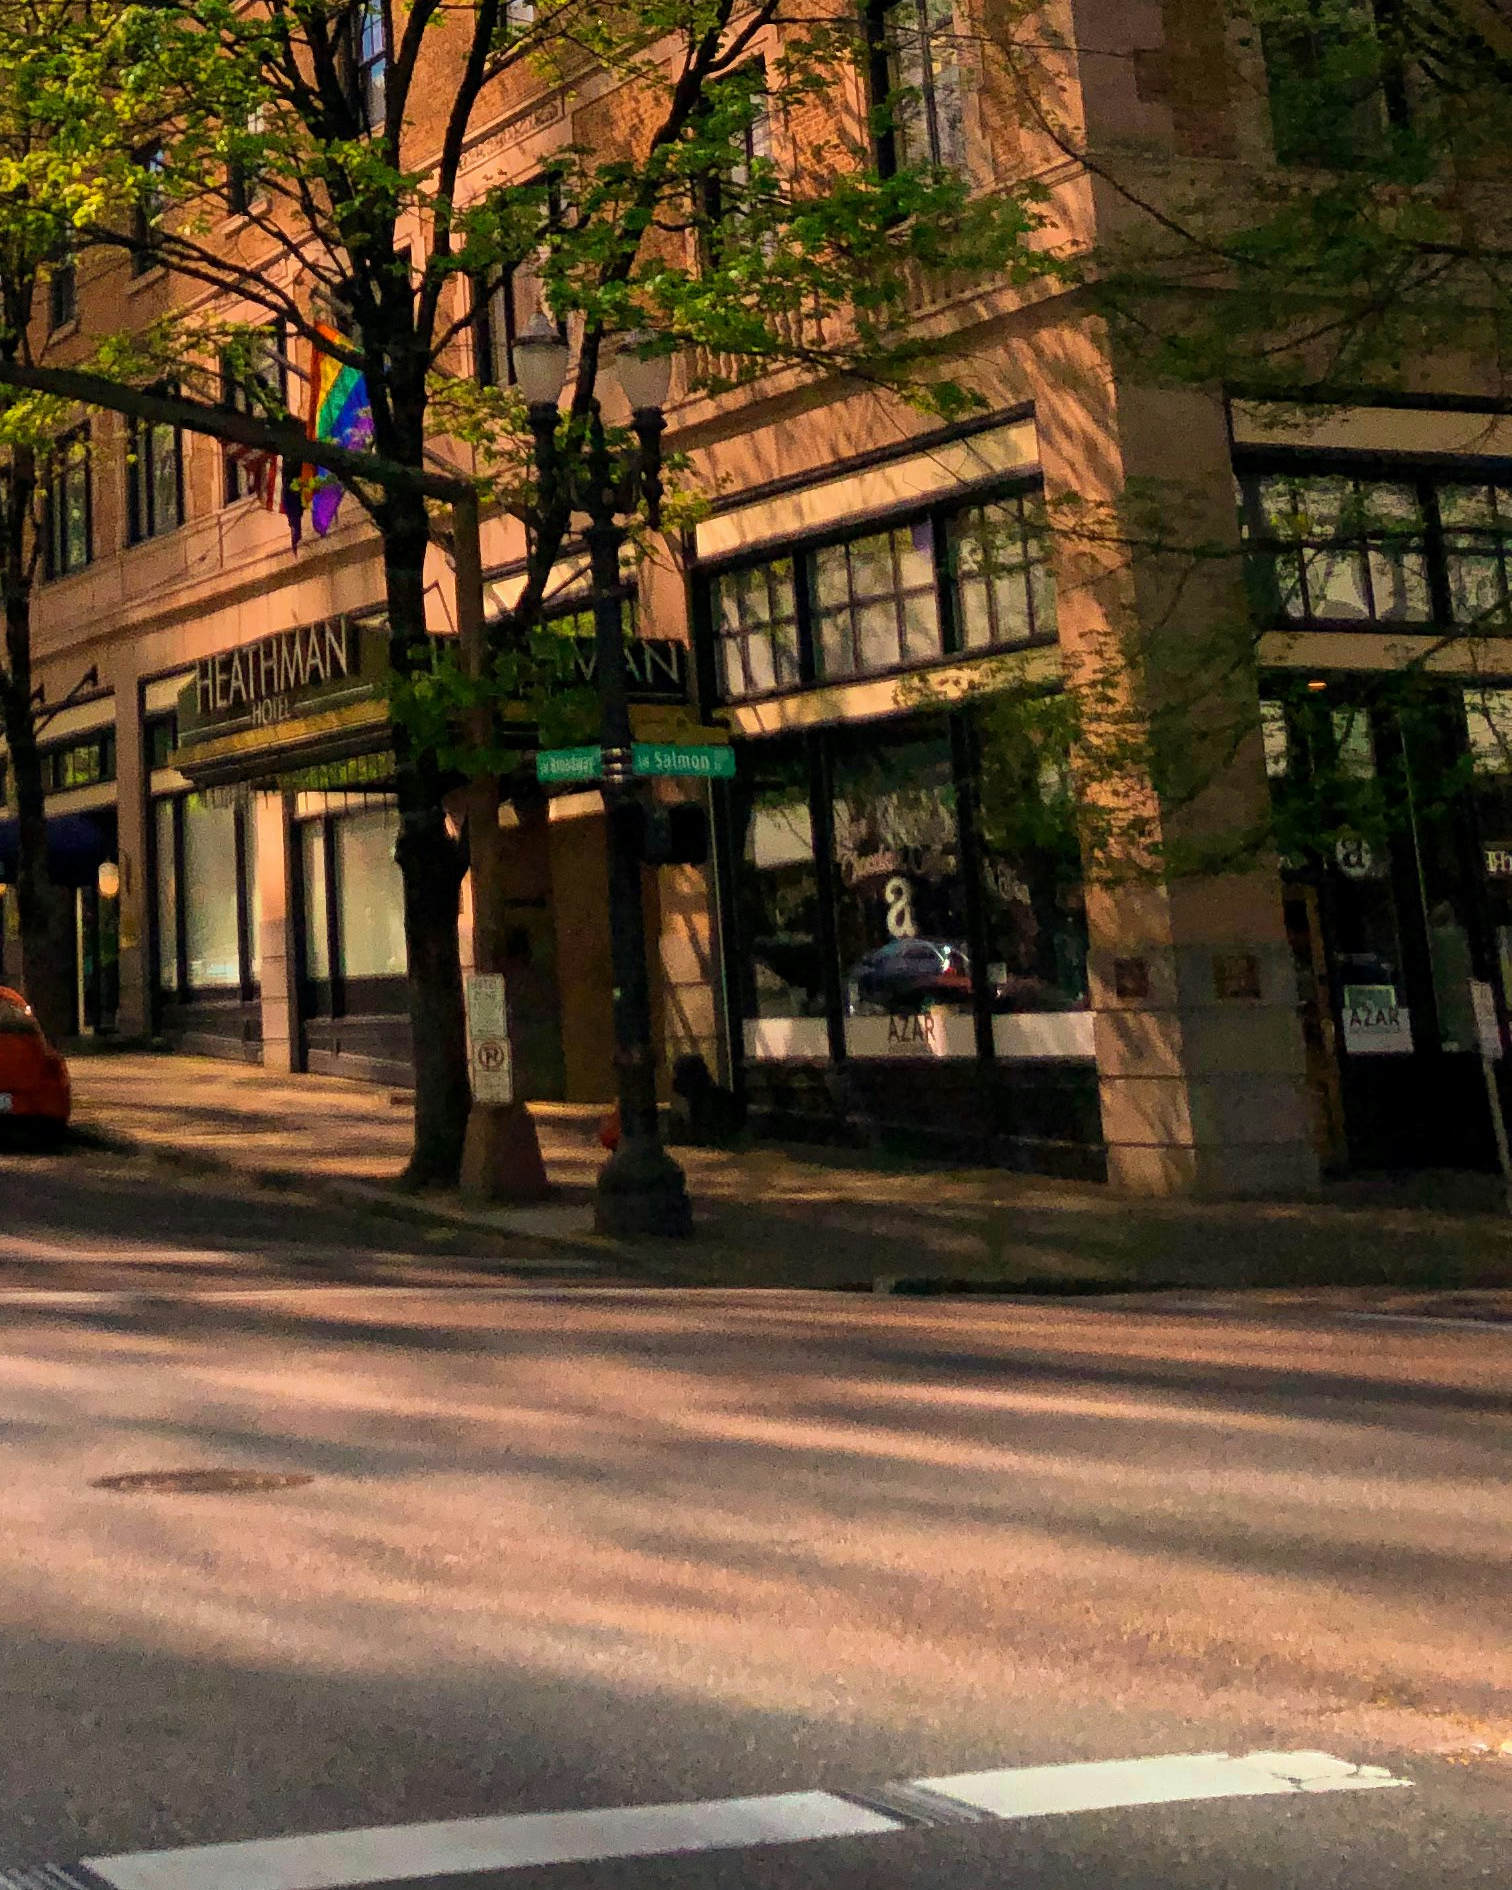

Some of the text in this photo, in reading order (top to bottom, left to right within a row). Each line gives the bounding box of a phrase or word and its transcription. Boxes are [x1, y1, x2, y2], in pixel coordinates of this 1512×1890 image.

[195, 614, 349, 714] HEATHMAN
[251, 695, 290, 725] HOTEL
[654, 750, 710, 770] Salmon
[888, 1013, 936, 1042] AZAR
